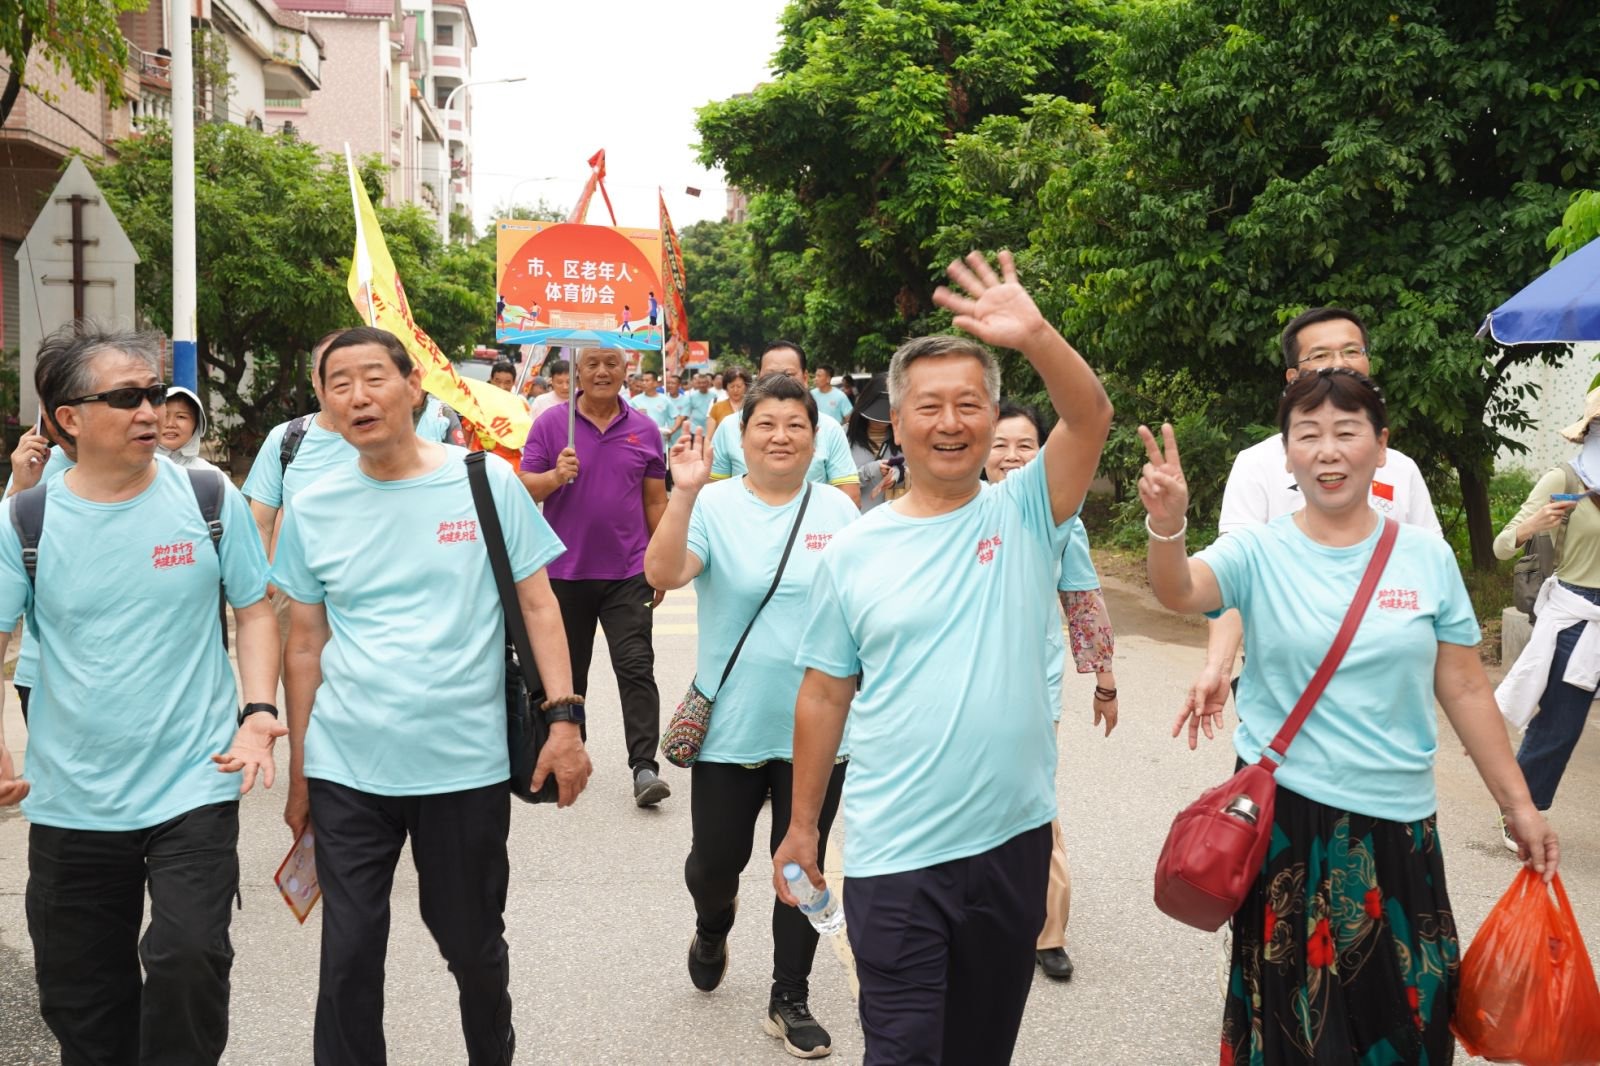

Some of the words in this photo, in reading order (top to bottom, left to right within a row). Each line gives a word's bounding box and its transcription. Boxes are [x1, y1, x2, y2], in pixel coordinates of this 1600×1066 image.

[527, 257, 633, 283] 市、区老年人
[545, 282, 615, 305] 体育协会
